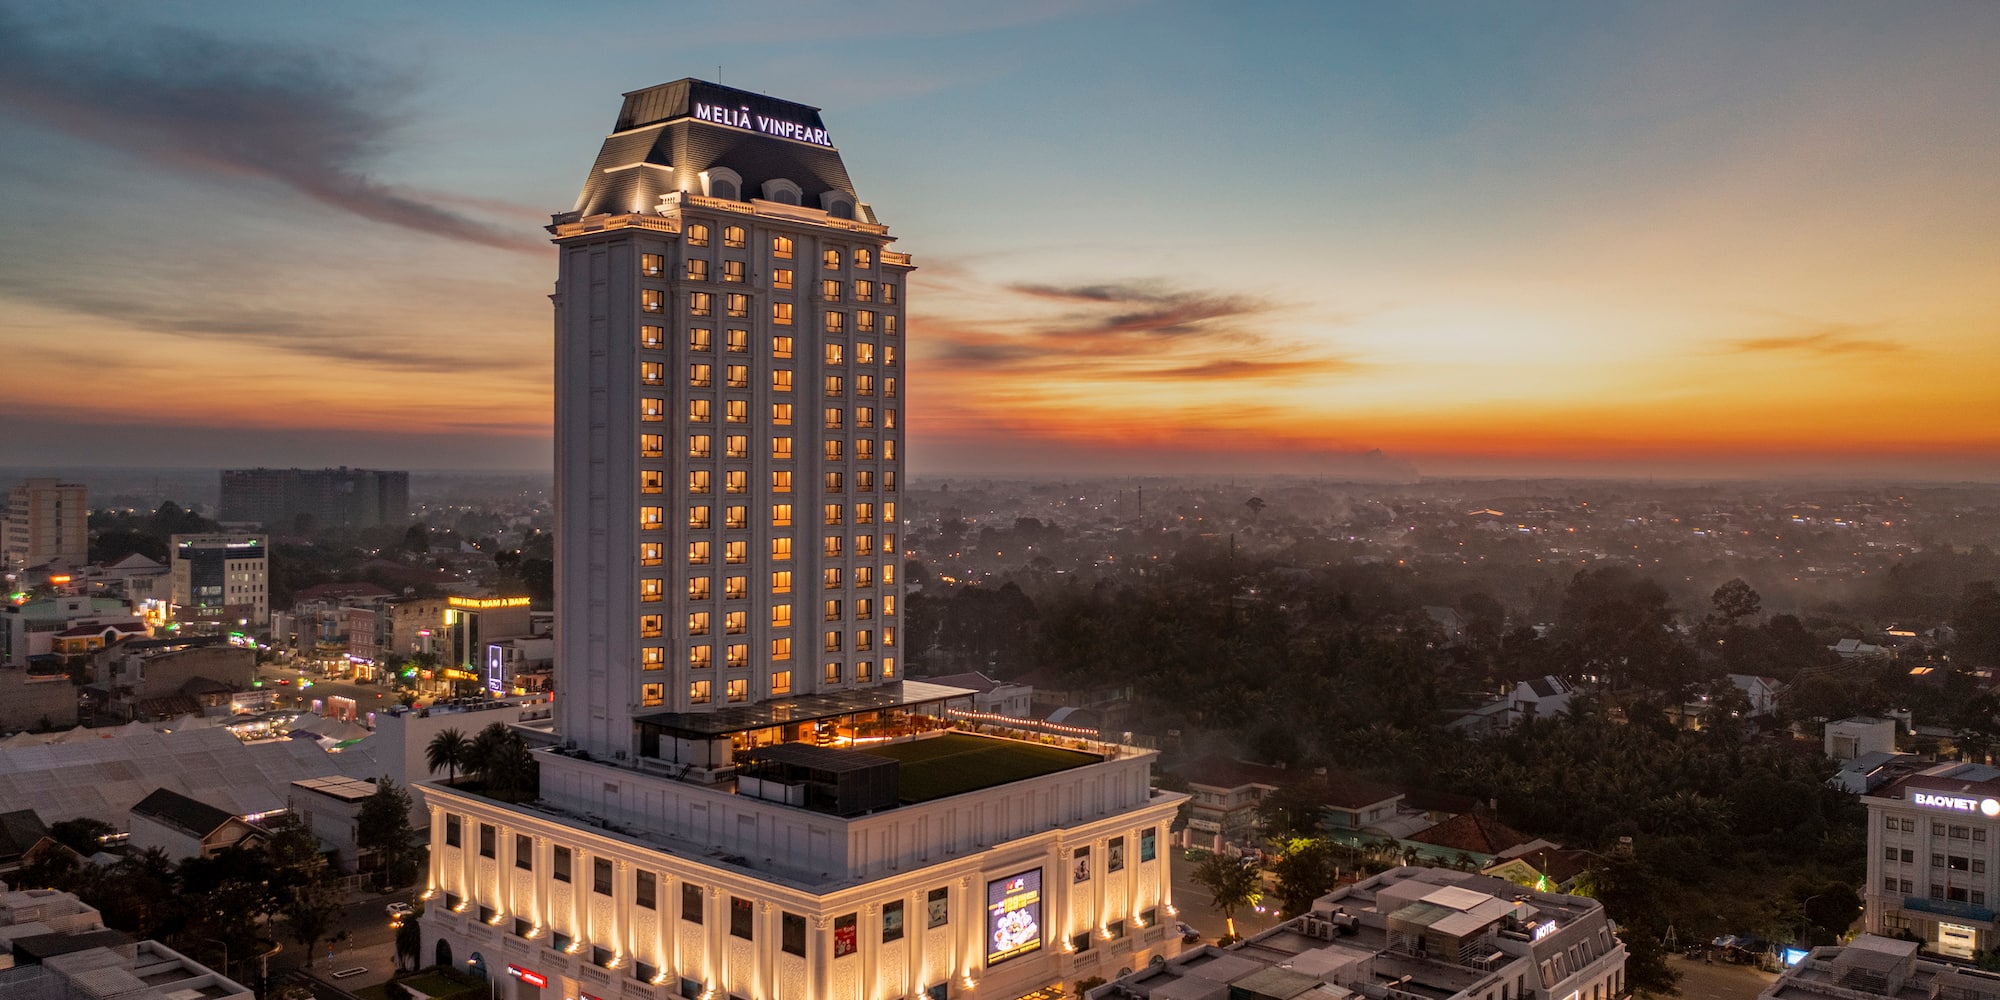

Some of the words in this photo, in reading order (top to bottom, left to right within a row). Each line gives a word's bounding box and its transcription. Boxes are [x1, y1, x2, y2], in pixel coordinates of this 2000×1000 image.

[757, 115, 831, 146] VINPEARL
[481, 599, 501, 609] NAM
[501, 599, 508, 607] A
[508, 597, 531, 606] BANK
[1915, 793, 1978, 811] BAOVIET
[1535, 919, 1557, 941] HOTEL
